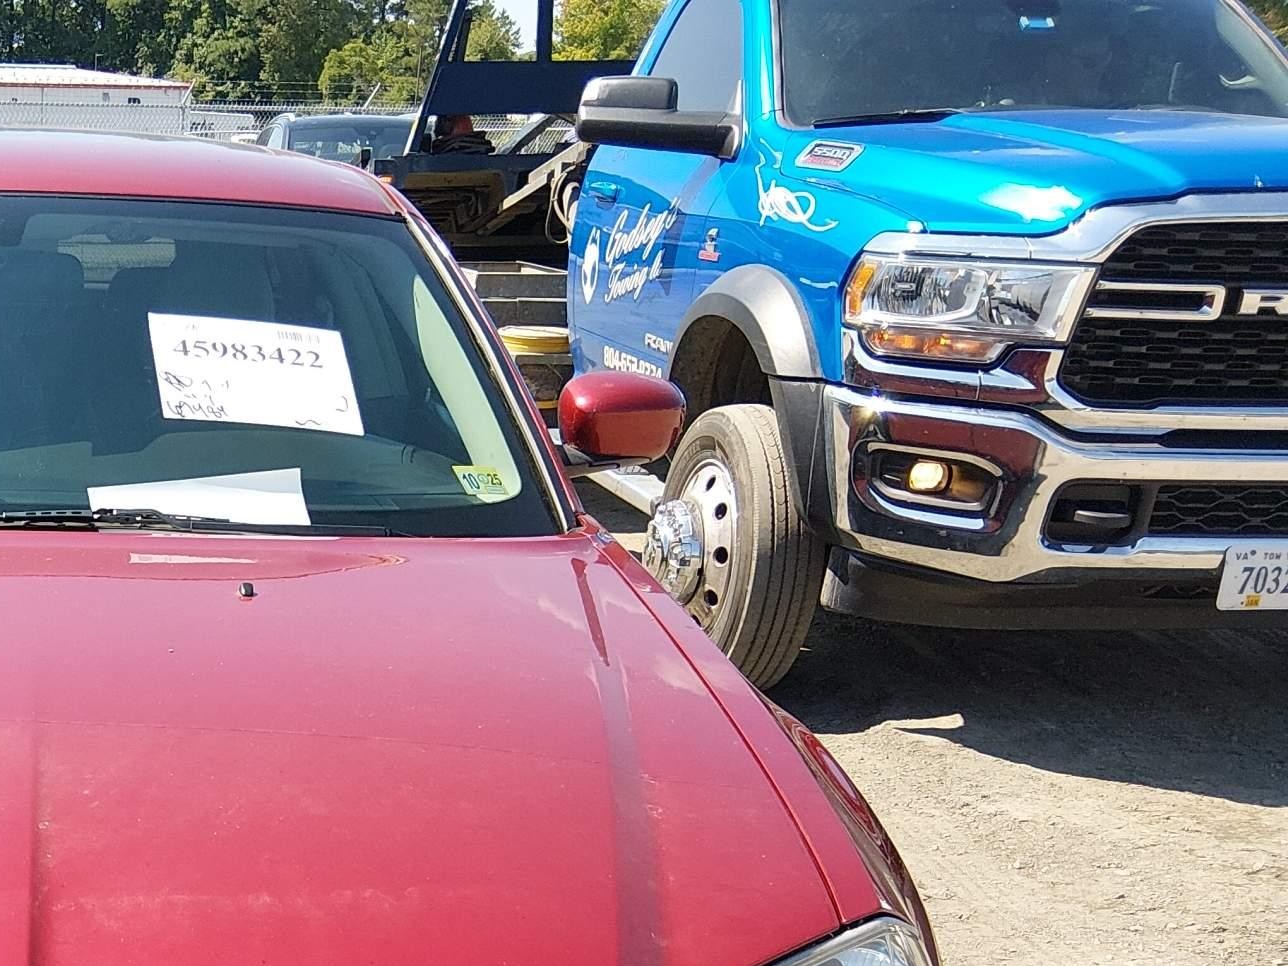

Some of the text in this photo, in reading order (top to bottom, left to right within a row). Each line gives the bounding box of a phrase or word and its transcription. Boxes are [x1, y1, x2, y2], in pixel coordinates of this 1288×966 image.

[605, 261, 649, 303] Towing
[173, 339, 323, 368] 45983422
[462, 473, 503, 490] 10 25
[1235, 552, 1282, 560] VA TOW
